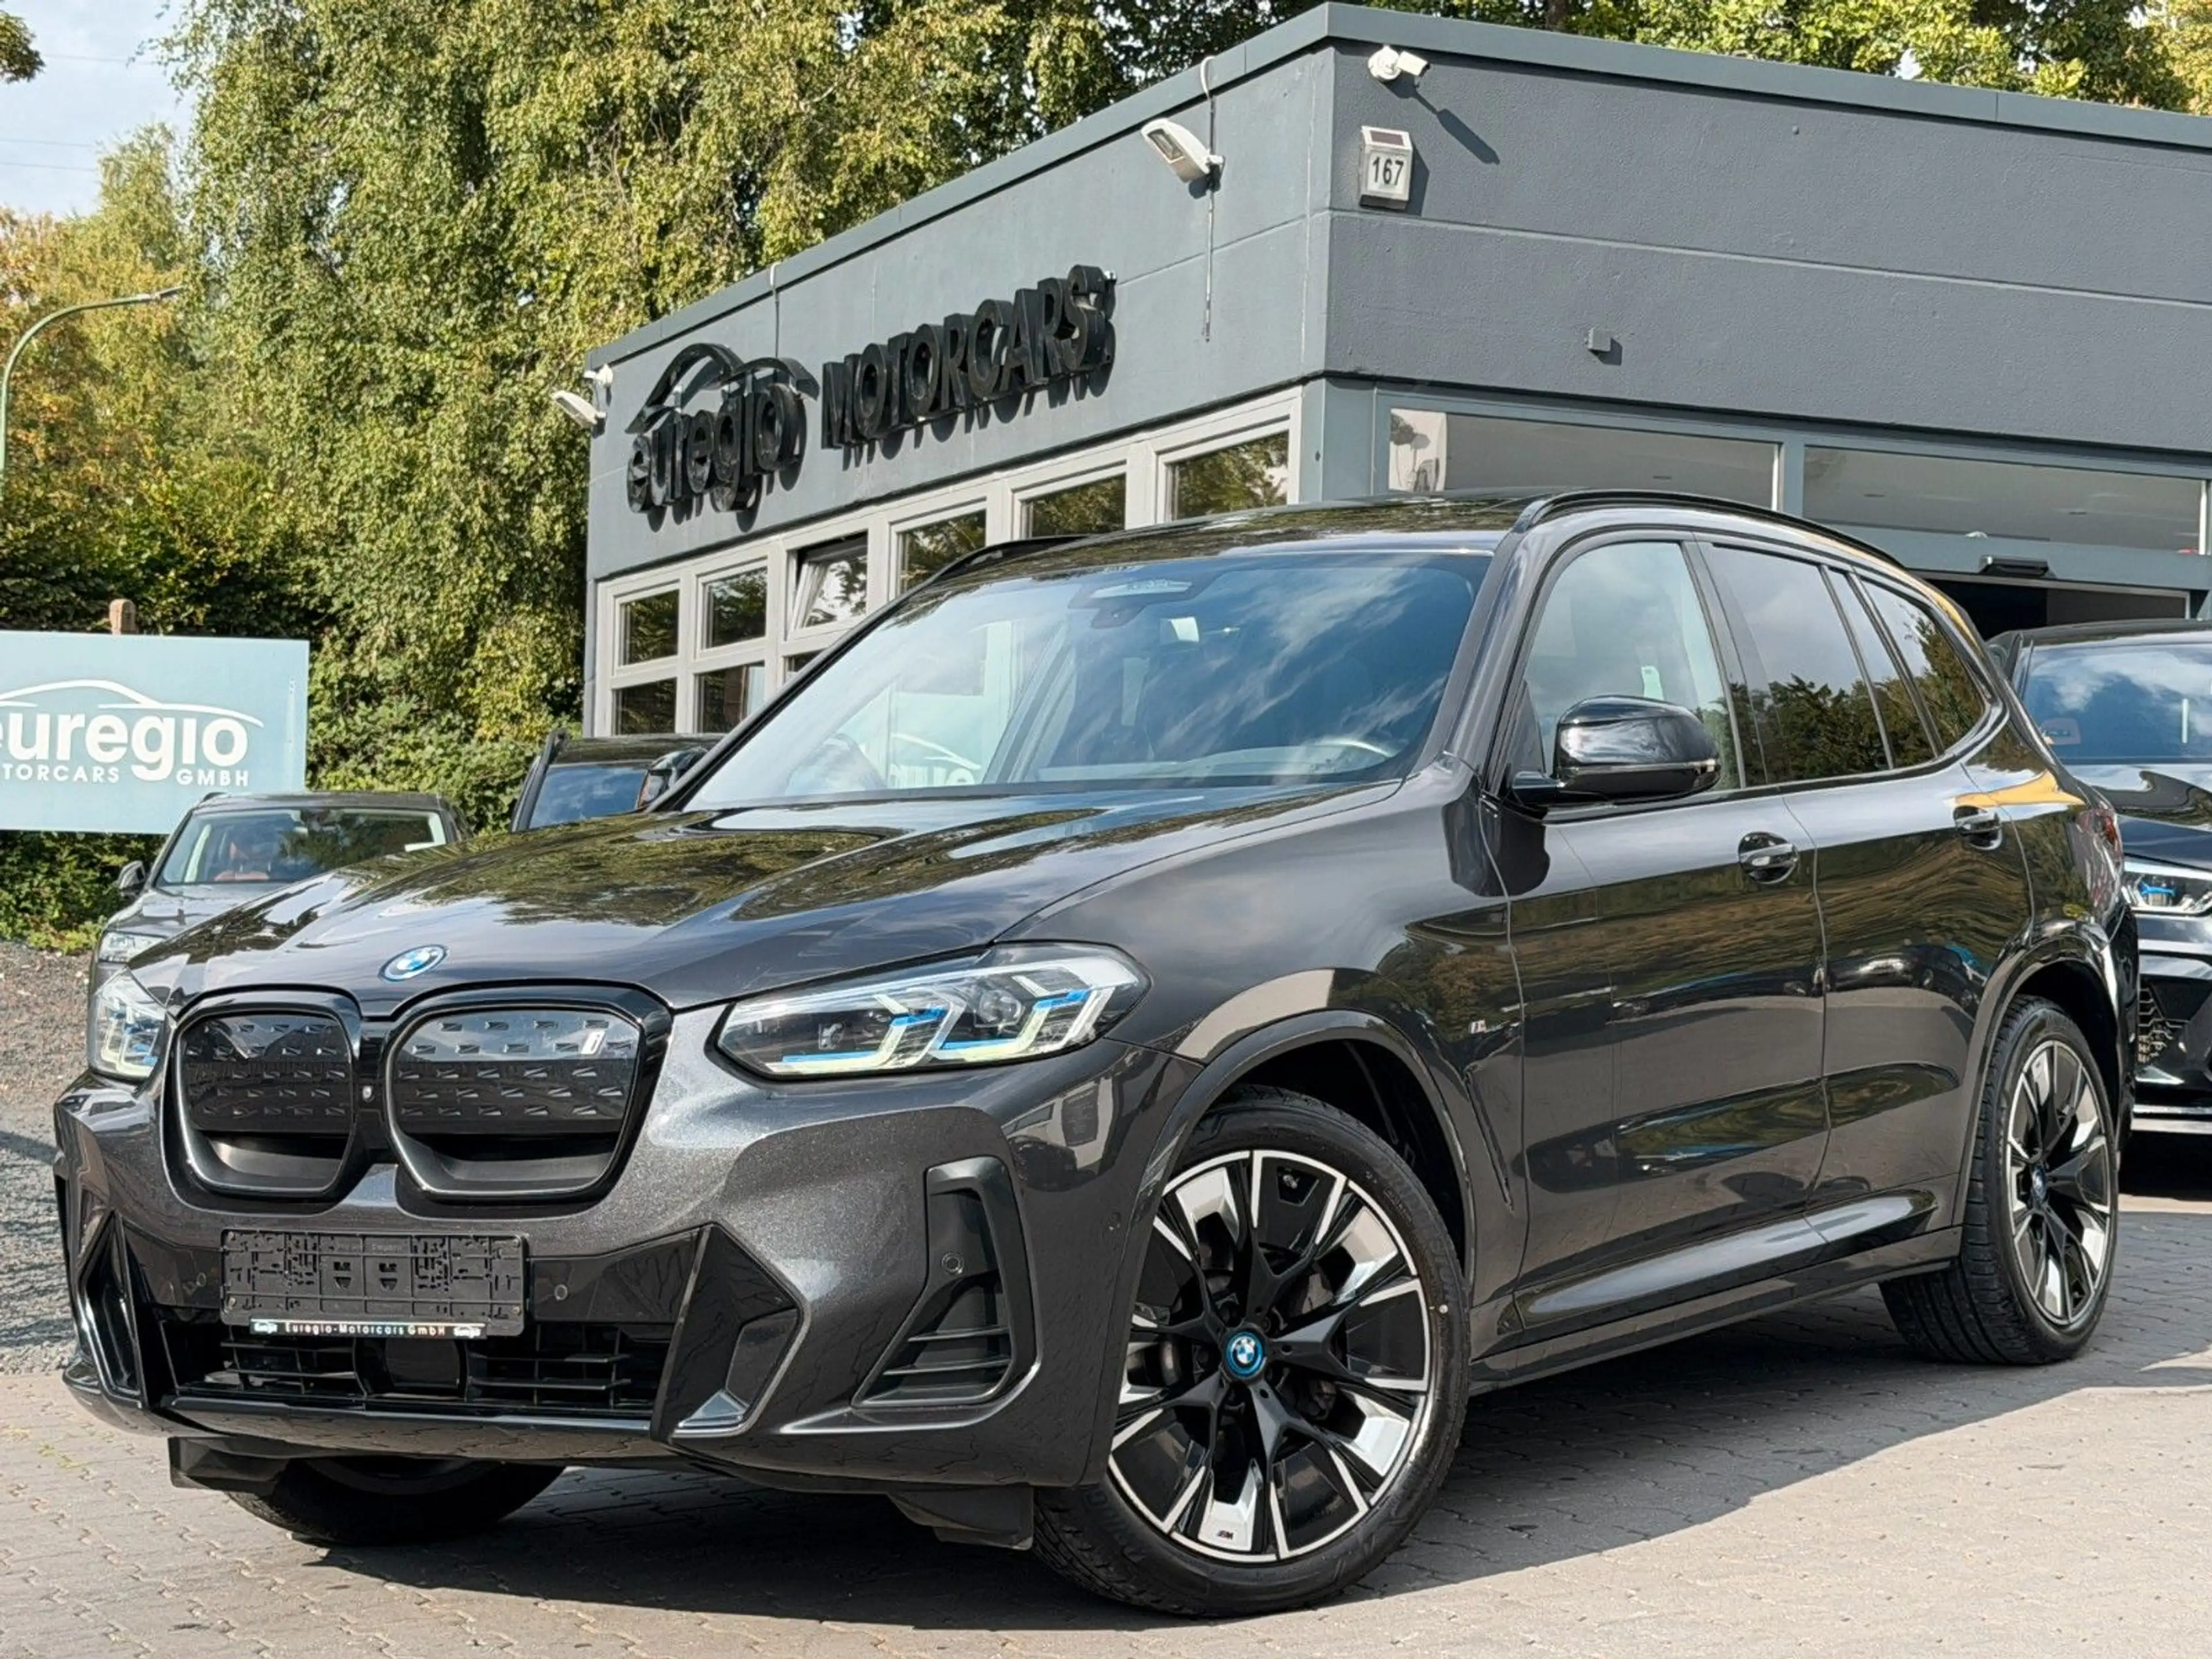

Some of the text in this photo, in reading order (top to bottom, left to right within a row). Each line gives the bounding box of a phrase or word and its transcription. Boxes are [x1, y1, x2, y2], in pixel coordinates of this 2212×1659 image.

[1372, 156, 1404, 186] 167
[627, 264, 1107, 513] euregio MOTORCARS
[0, 713, 248, 781] uregio
[176, 768, 249, 787] GMBH
[408, 1325, 446, 1336] GmbH
